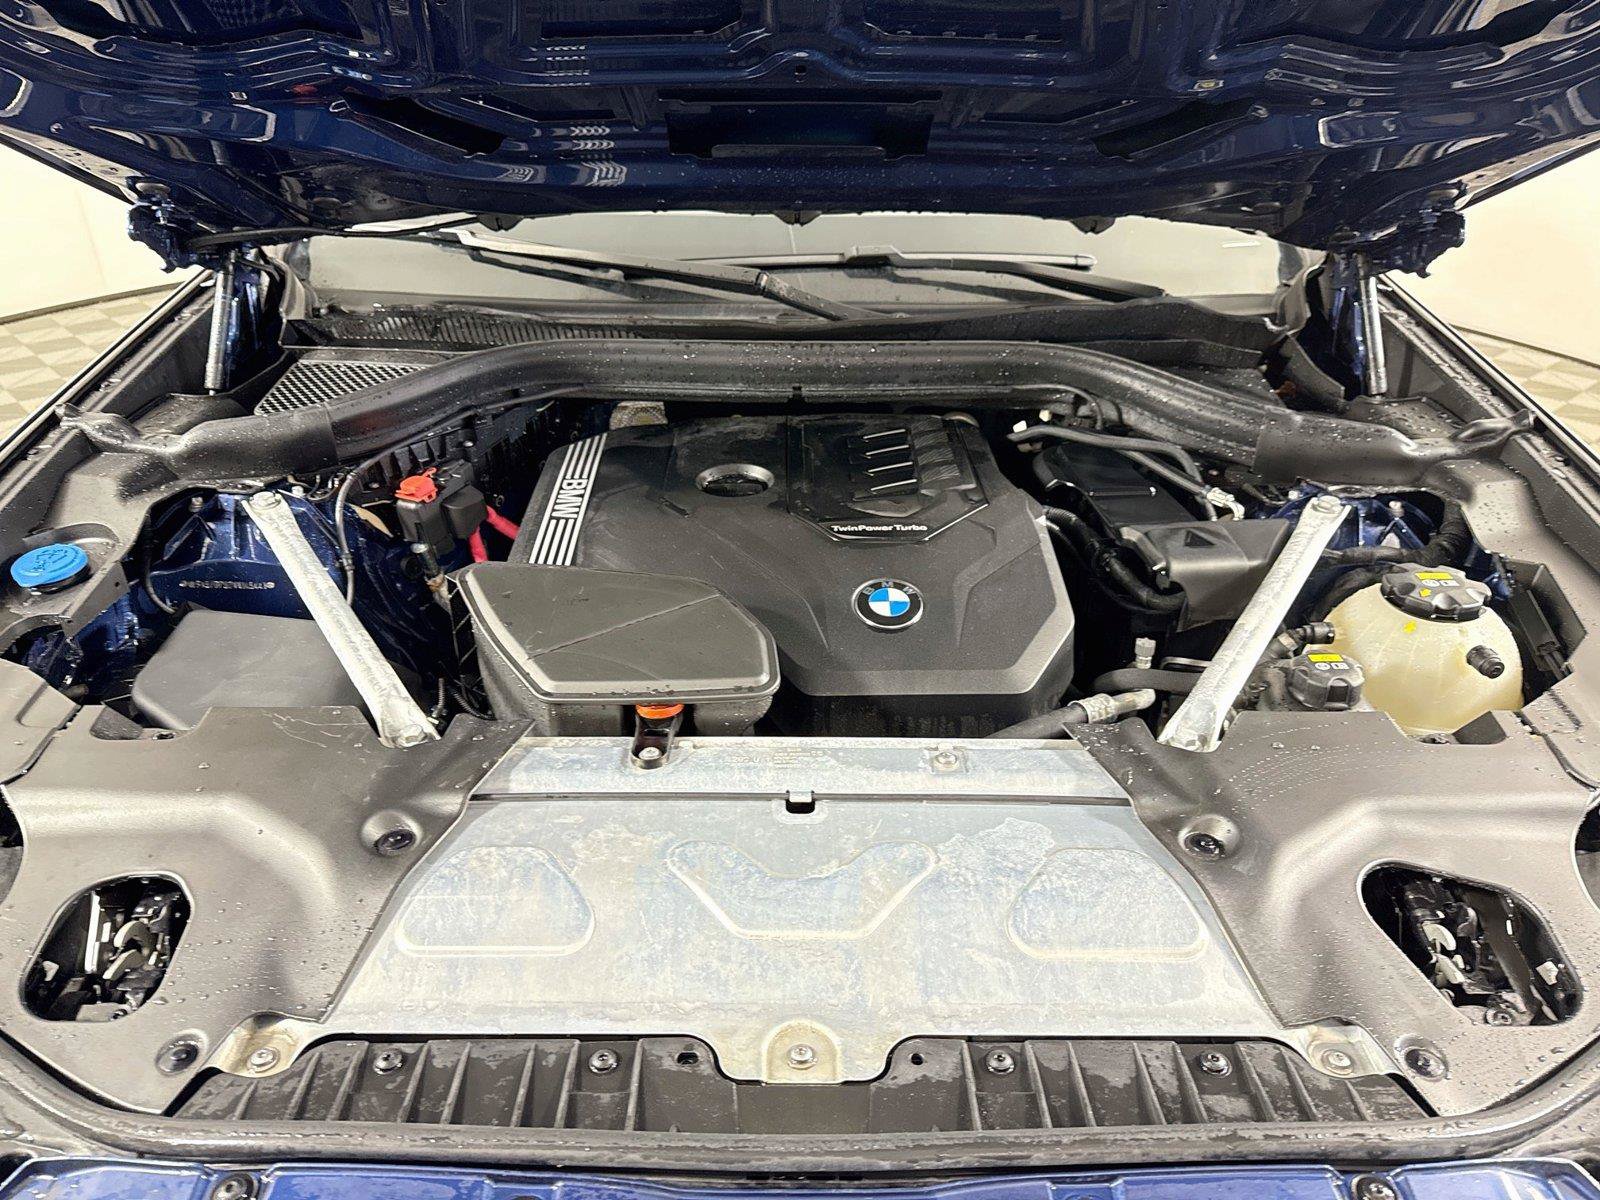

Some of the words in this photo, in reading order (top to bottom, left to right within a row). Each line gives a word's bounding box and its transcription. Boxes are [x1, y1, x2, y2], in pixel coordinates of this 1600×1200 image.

[551, 479, 588, 519] BMW
[831, 524, 893, 532] TwinPower
[862, 580, 917, 595] BMW
